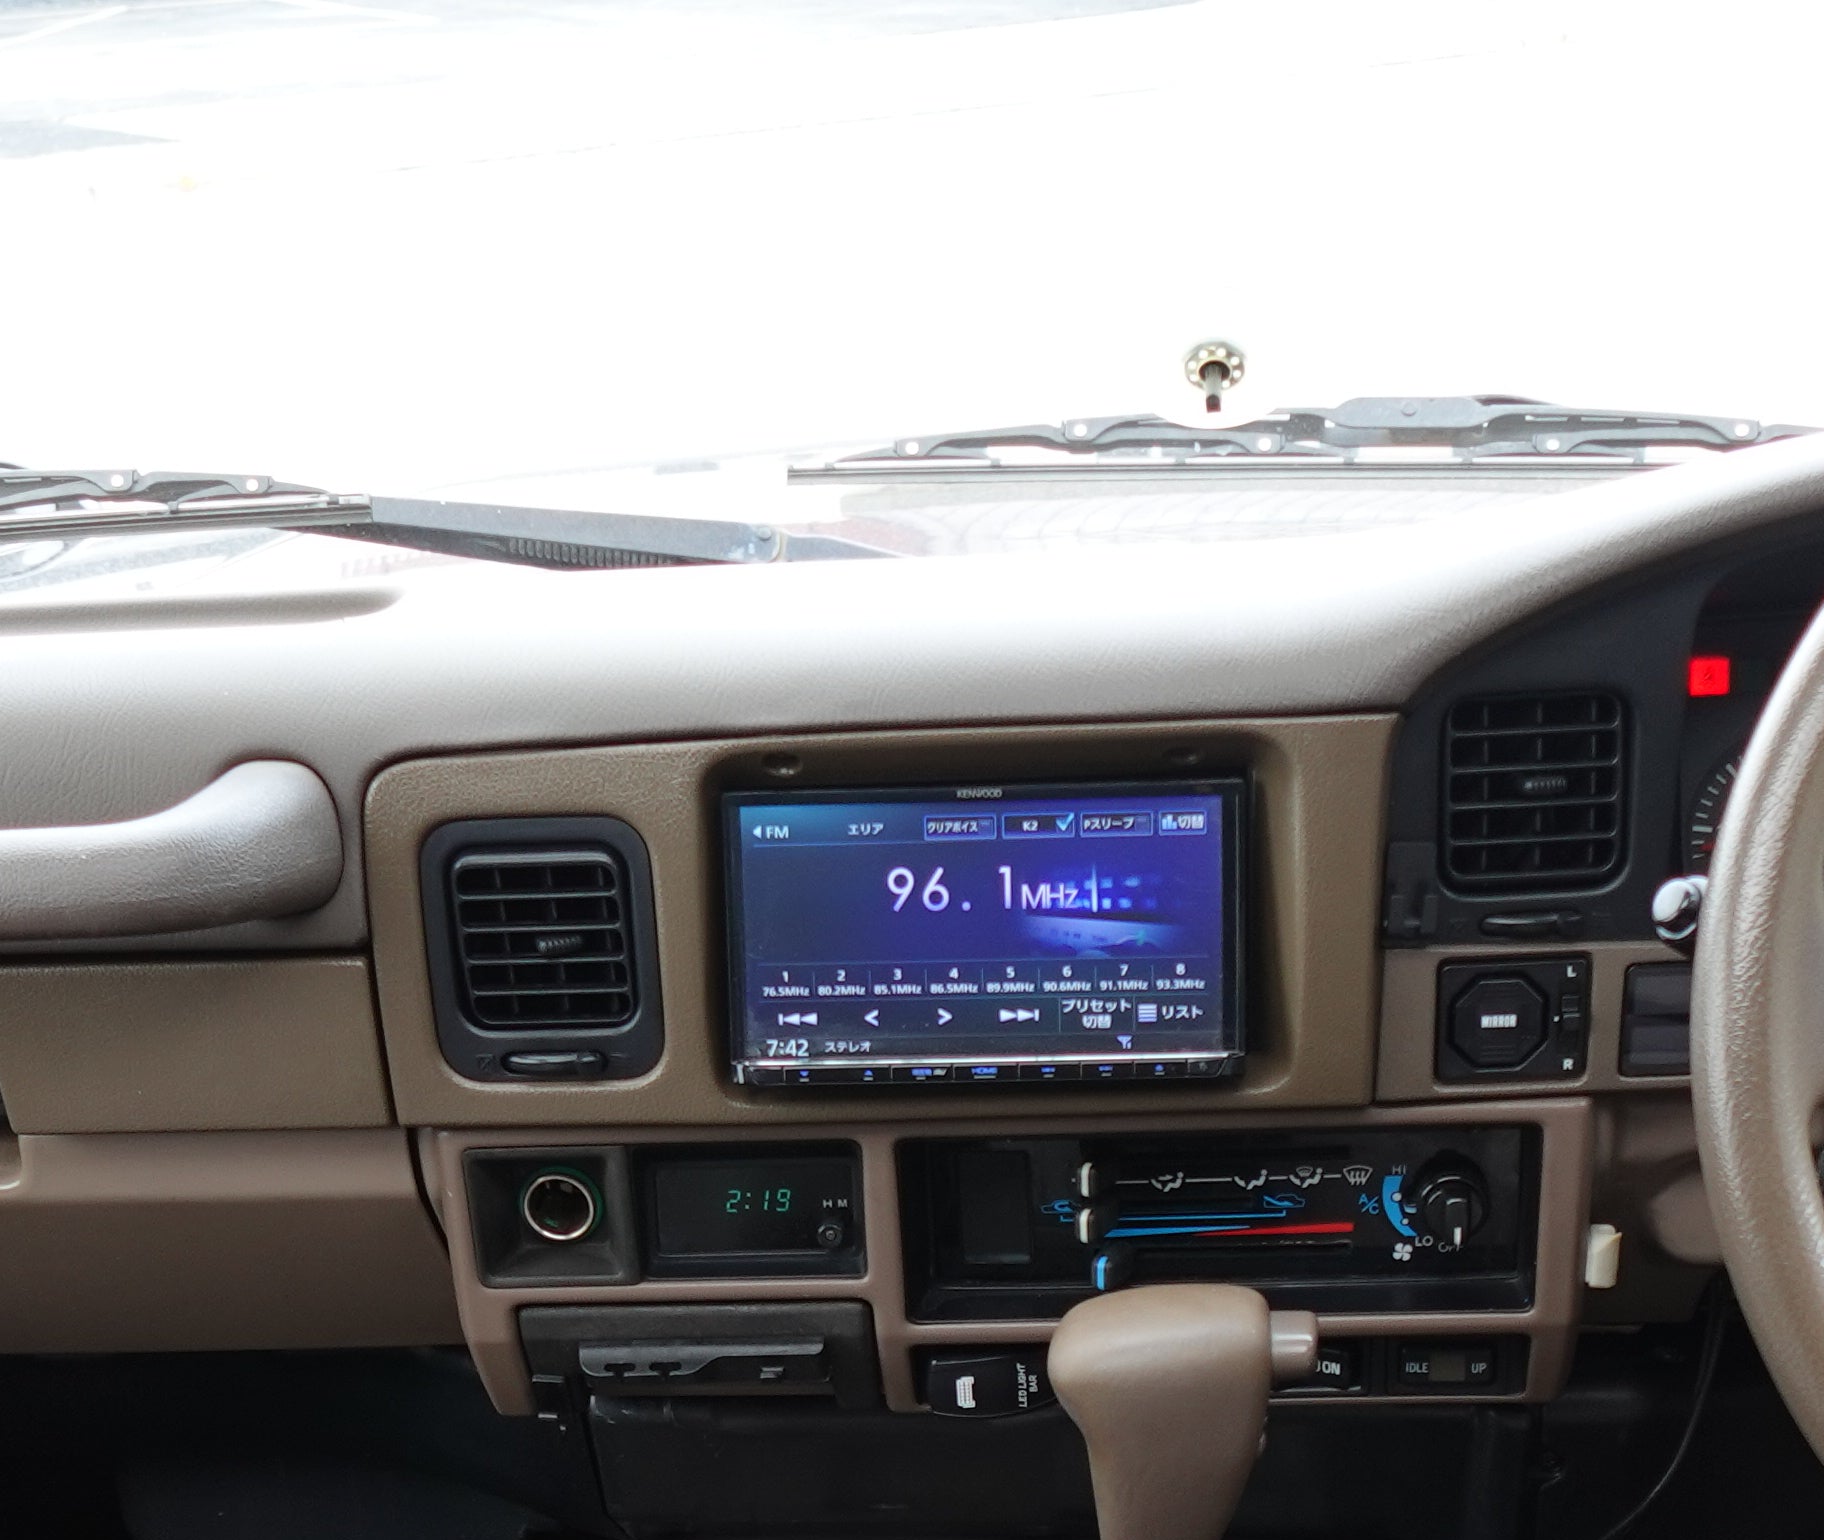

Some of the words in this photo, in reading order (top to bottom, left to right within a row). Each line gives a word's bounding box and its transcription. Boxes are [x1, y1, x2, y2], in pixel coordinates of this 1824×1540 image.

[956, 788, 1002, 799] KENWOOD
[766, 825, 789, 839] FM
[847, 823, 883, 836] エリア
[1022, 820, 1038, 831] K2
[837, 969, 846, 982] 2
[893, 968, 902, 981] 3
[949, 967, 959, 980] 4
[1006, 966, 1015, 978] 5
[1062, 965, 1072, 977] 6
[1120, 964, 1129, 976] 7
[1176, 963, 1186, 975] 8
[1566, 965, 1577, 978] L
[782, 971, 789, 983] 1
[1161, 1004, 1204, 1020] リスト
[1480, 1013, 1518, 1029] MIRROR
[766, 1038, 809, 1057] 7:42
[825, 1040, 871, 1053] ステレオ
[1562, 1057, 1574, 1071] R
[1392, 1165, 1407, 1175] HI
[726, 1189, 791, 1213] 2:19
[1358, 1193, 1380, 1214] A/C
[1414, 1235, 1434, 1248] LO
[1405, 1362, 1429, 1374] IDLE
[1471, 1362, 1487, 1374] UP
[1016, 1362, 1027, 1389] LIGHT
[1028, 1374, 1039, 1392] BAR
[1017, 1390, 1028, 1408] LED
